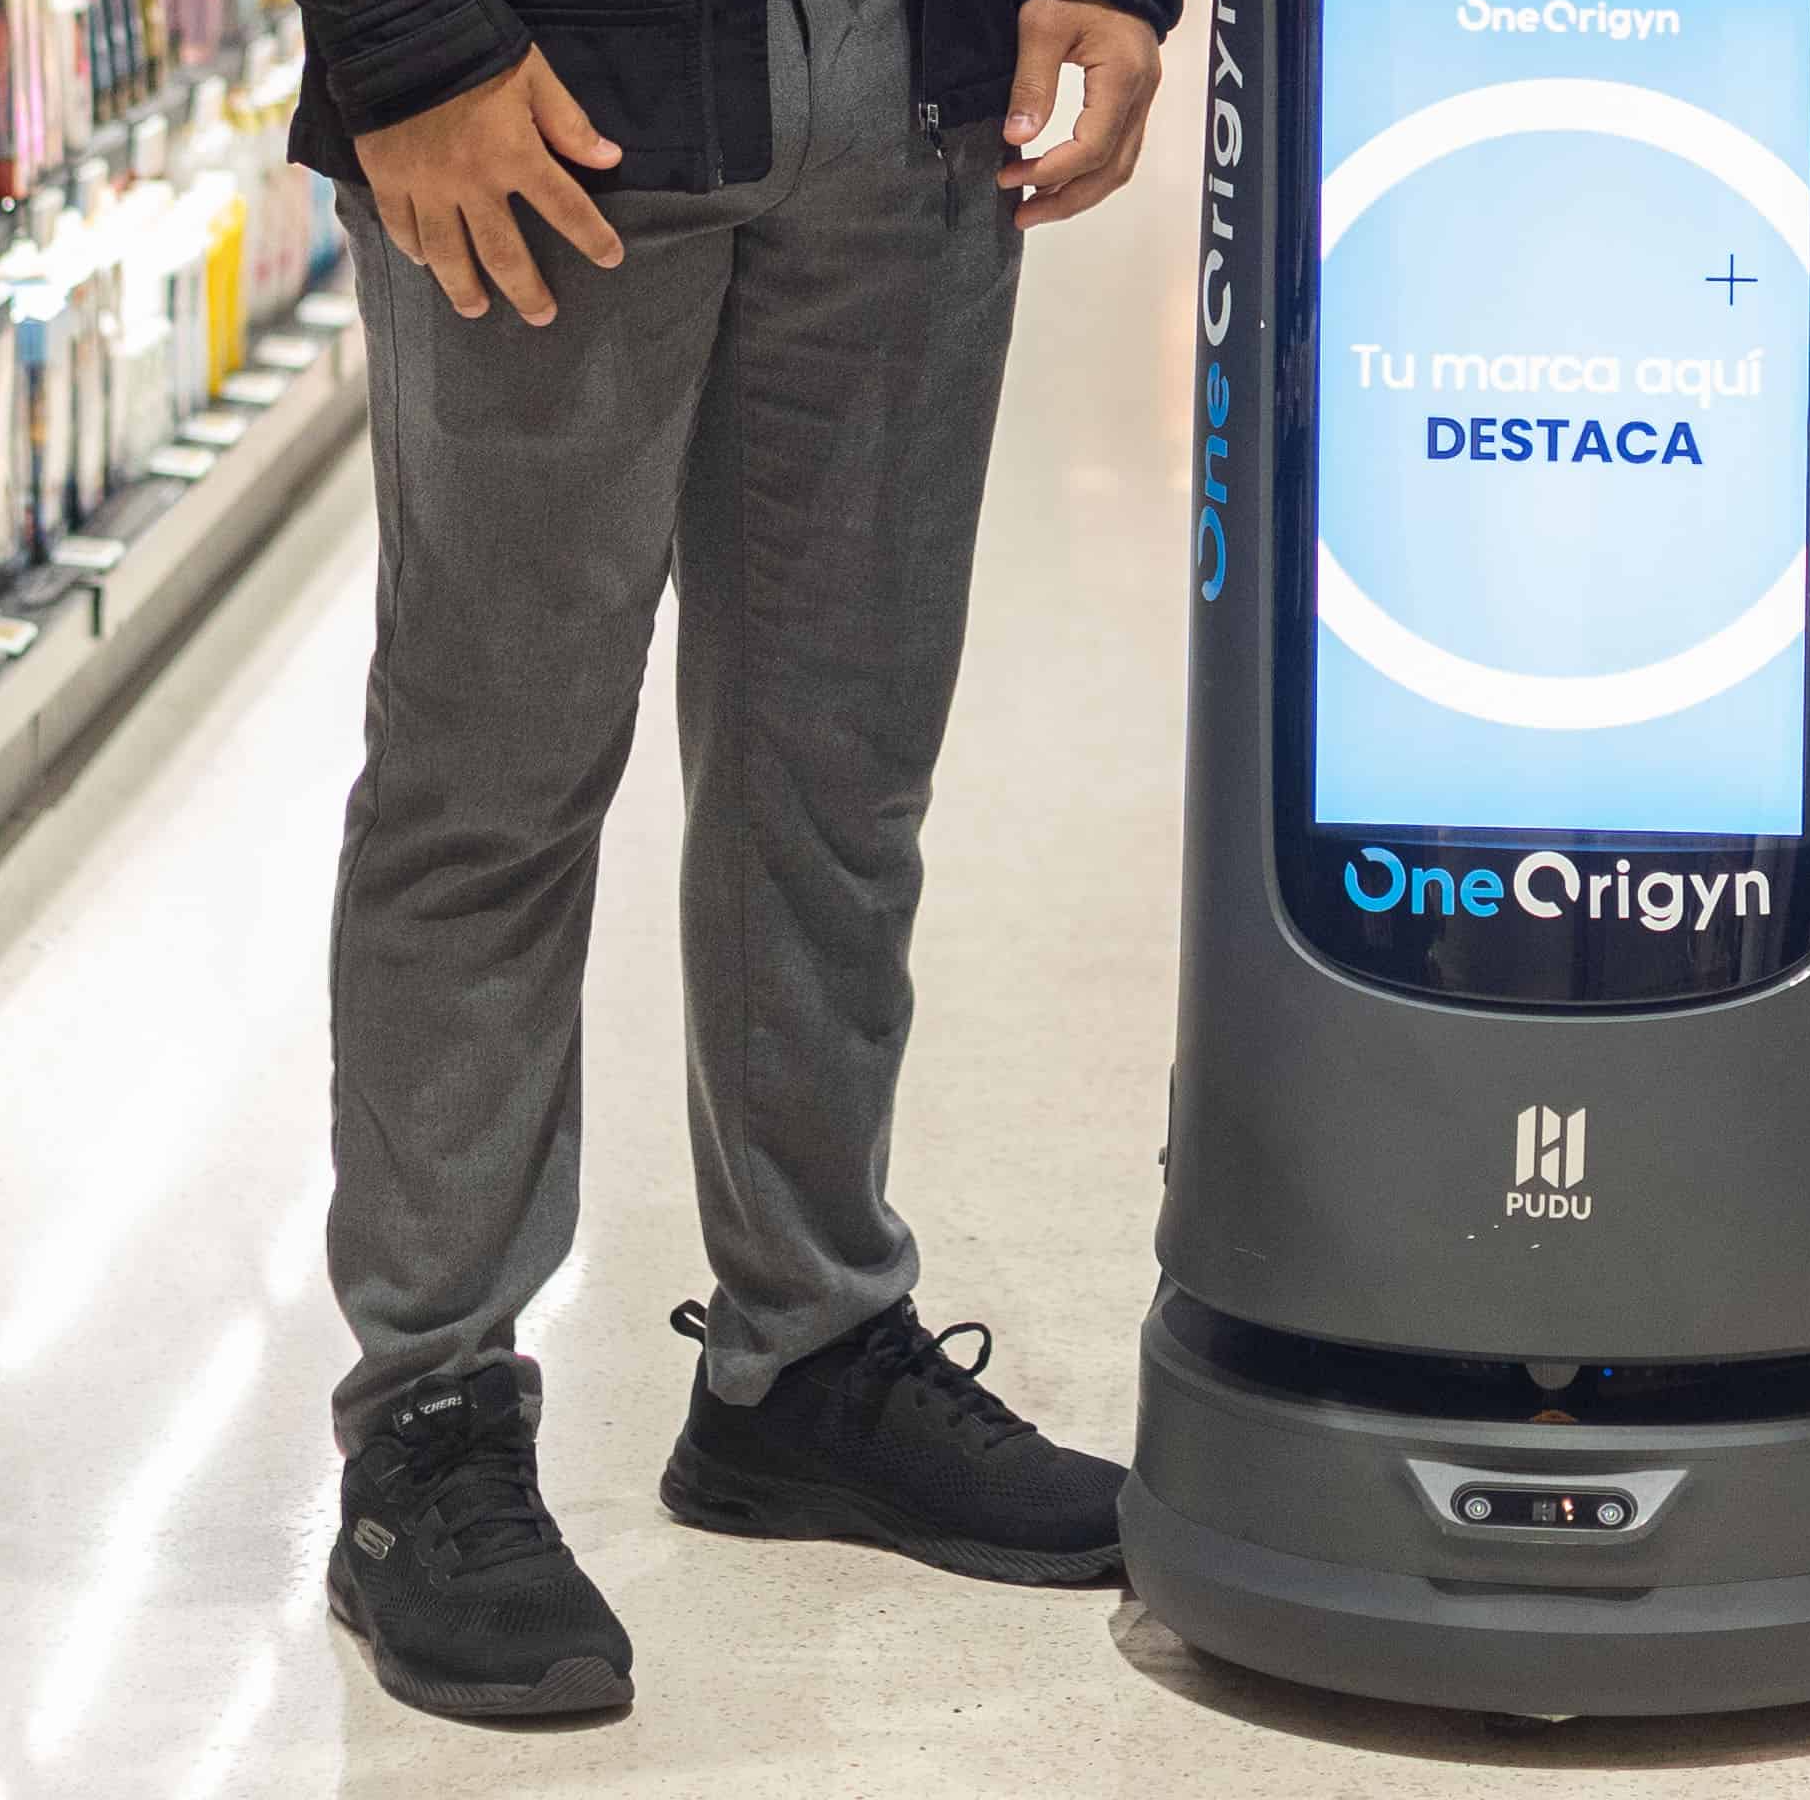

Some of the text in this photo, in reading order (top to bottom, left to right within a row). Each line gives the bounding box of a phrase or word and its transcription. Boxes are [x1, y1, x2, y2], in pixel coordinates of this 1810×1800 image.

[1350, 343, 1765, 409] Tu marca aquí
[1425, 417, 1703, 465] DESTACA
[1344, 846, 1771, 931] OneOrigyn
[1506, 1192, 1592, 1221] PUDU
[402, 1395, 463, 1425] SCHER
